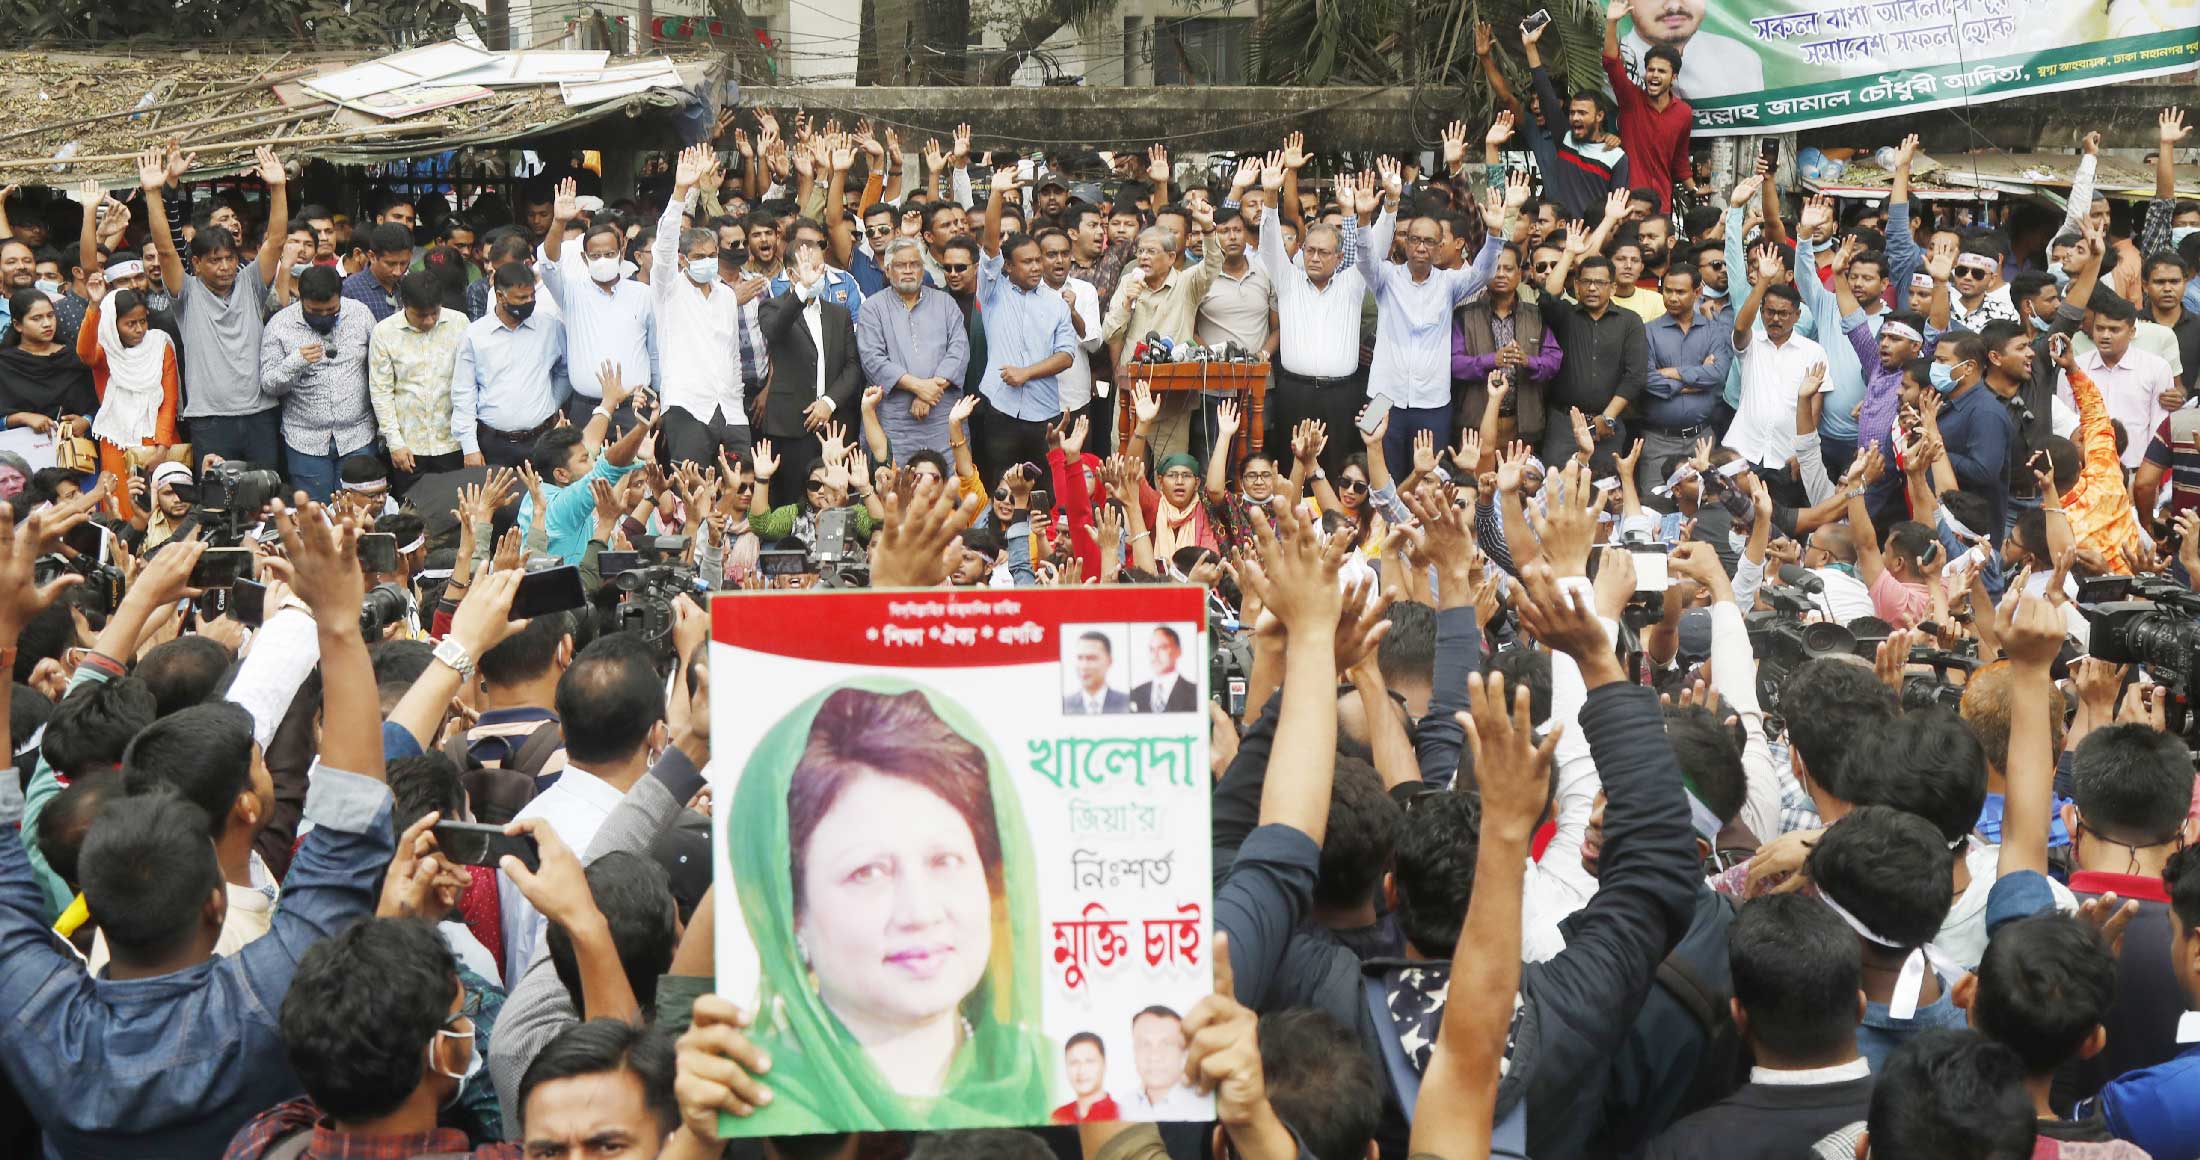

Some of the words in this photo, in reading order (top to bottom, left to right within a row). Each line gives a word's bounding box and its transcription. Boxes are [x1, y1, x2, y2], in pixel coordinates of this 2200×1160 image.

[1752, 12, 1819, 41] সকল
[1824, 3, 1869, 29] বাধা
[1800, 34, 1888, 65] সমাবেশ
[1889, 24, 1955, 52] সফল
[1962, 15, 2016, 44] হোক
[1765, 89, 1852, 116] জামাল
[1858, 74, 1938, 102] চৌধুরী
[1944, 64, 2032, 91] আদিত্য,
[2113, 51, 2137, 64] ঢাকা
[2140, 44, 2184, 60] মহানগর
[1027, 734, 1198, 788] খালেদা
[1071, 848, 1175, 891] নিঃশর্ত
[1051, 902, 1129, 992] মুক্তি
[1142, 902, 1202, 966] চাই
